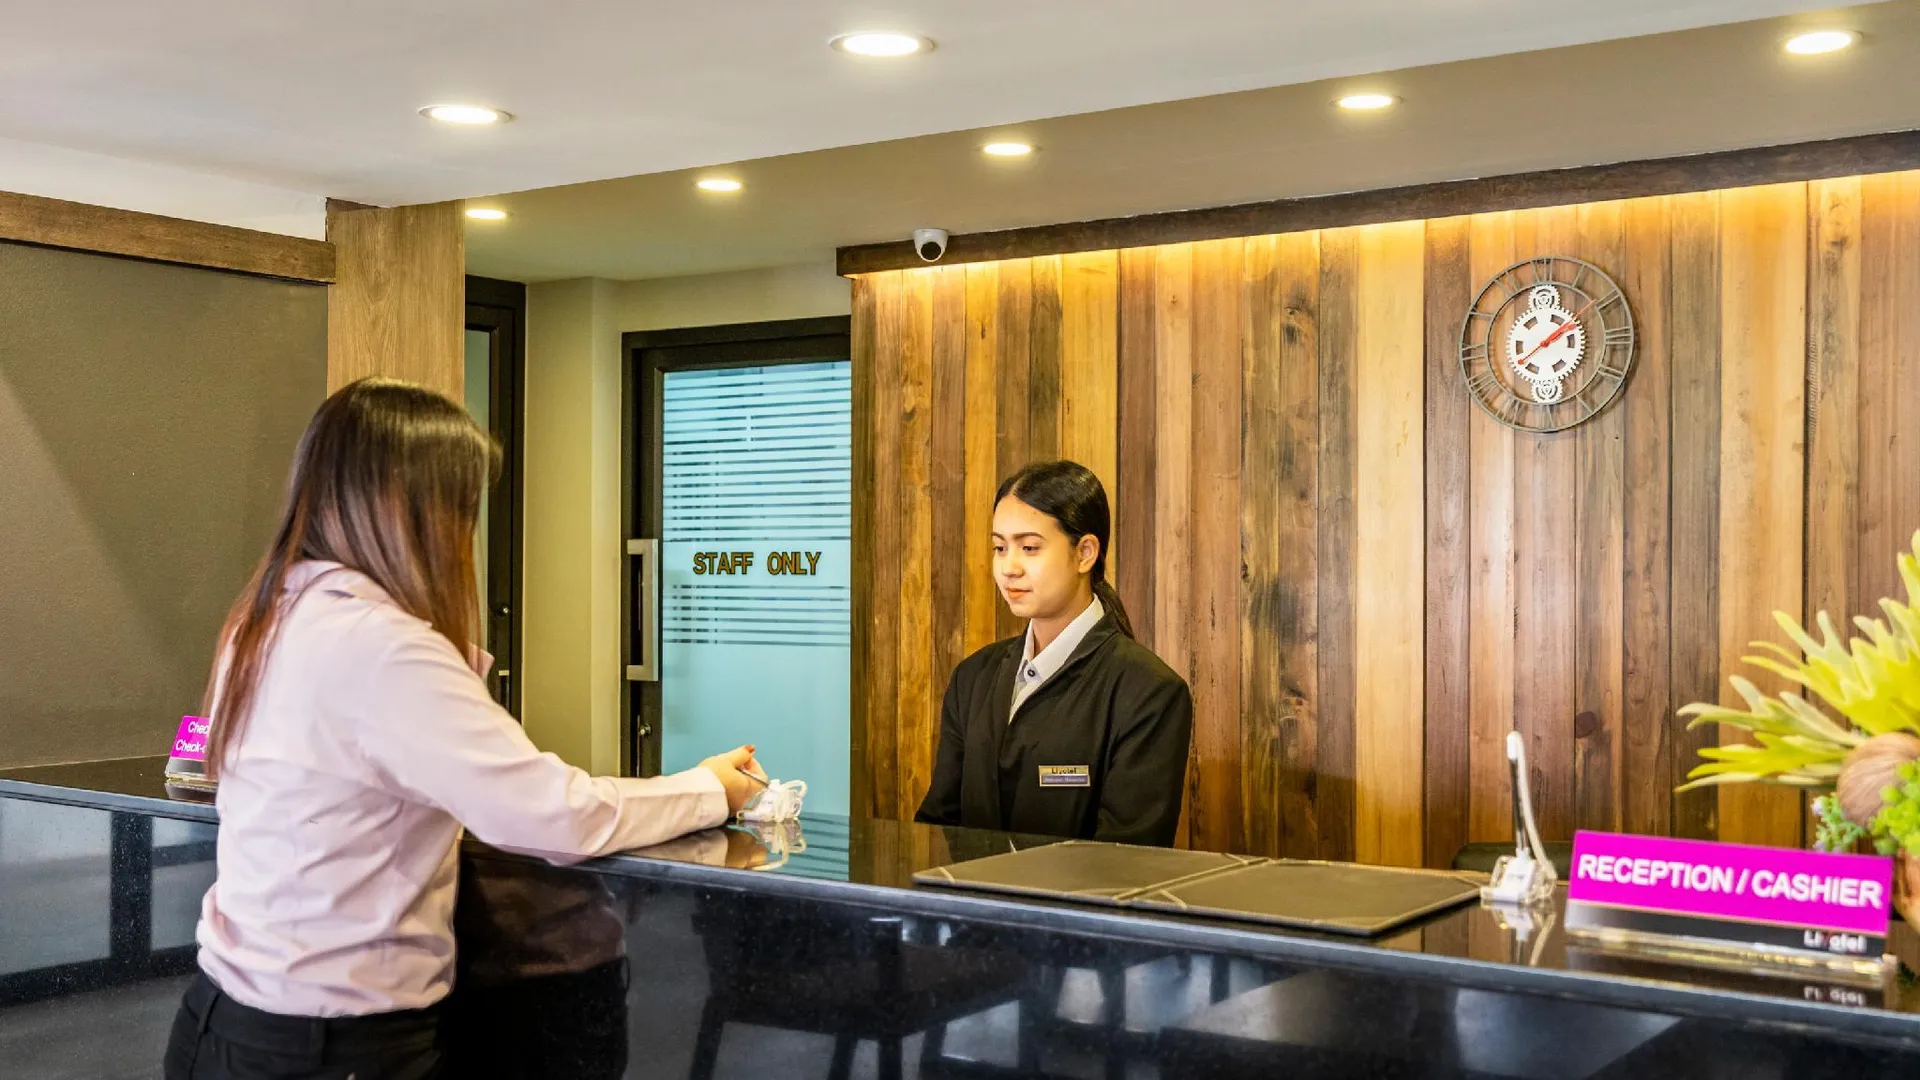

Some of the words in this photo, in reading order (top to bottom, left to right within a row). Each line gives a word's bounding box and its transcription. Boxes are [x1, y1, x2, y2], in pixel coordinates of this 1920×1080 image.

[693, 552, 754, 575] STAFF
[767, 552, 822, 576] ONLY
[1577, 853, 1735, 894] RECEPTION
[1735, 867, 1750, 895] /
[1752, 869, 1884, 909] CASHIER
